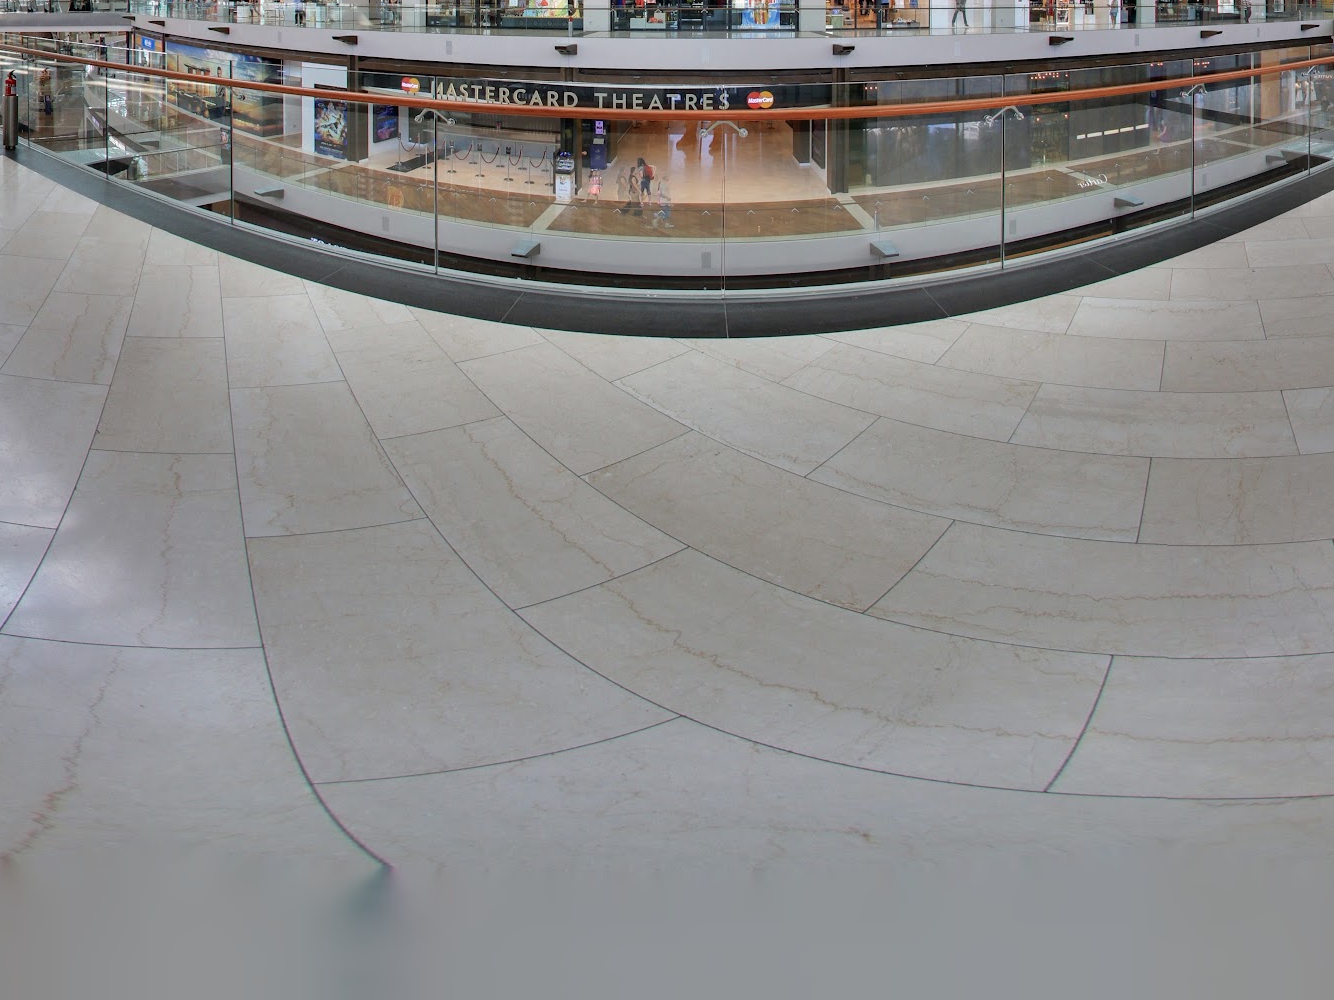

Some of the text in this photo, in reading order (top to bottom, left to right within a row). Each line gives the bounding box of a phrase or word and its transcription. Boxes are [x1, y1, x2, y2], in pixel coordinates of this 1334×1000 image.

[430, 80, 730, 110] MASTERCARD THEATRES
[747, 96, 774, 105] MasterCard
